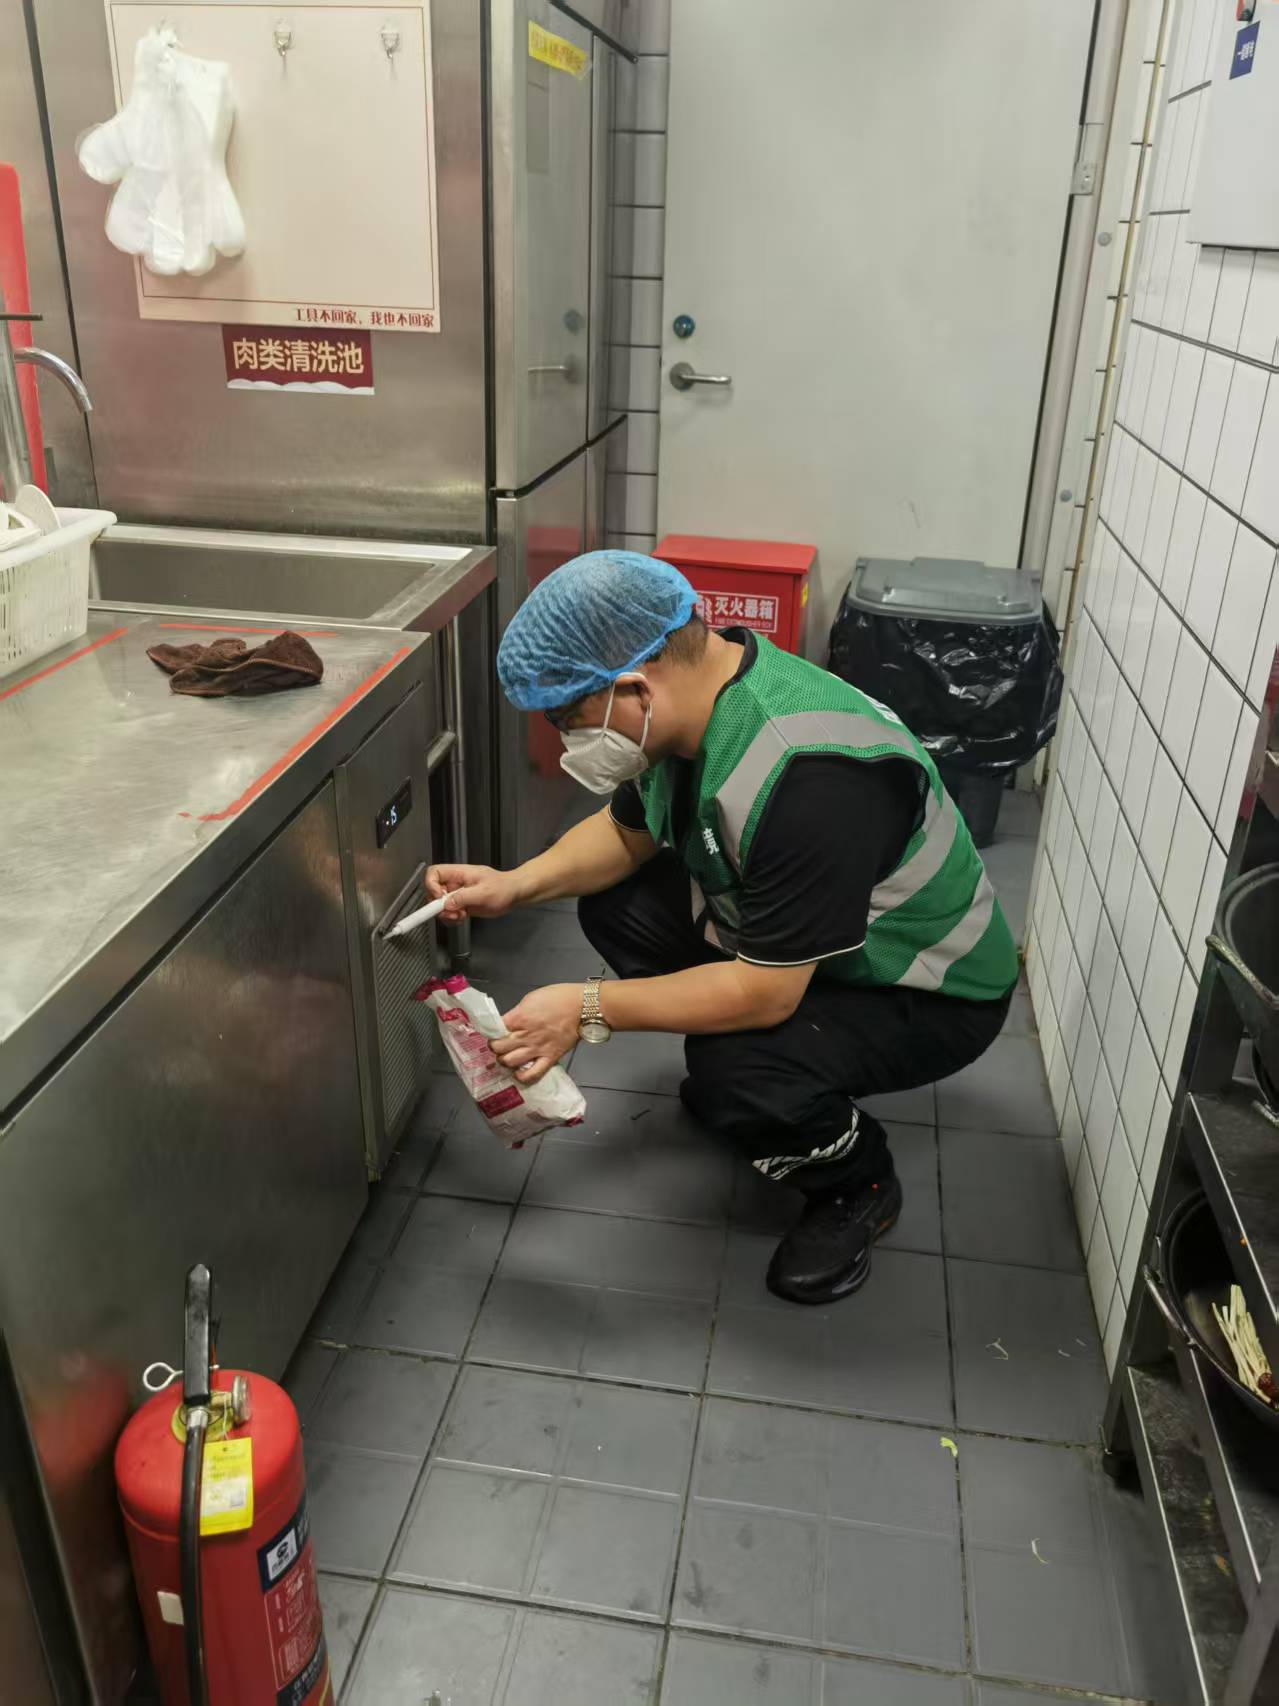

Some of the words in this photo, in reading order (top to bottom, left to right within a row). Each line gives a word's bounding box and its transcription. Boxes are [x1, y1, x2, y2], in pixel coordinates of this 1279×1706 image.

[232, 337, 364, 374] 肉类清洗池
[714, 597, 774, 619] 灭火器箱
